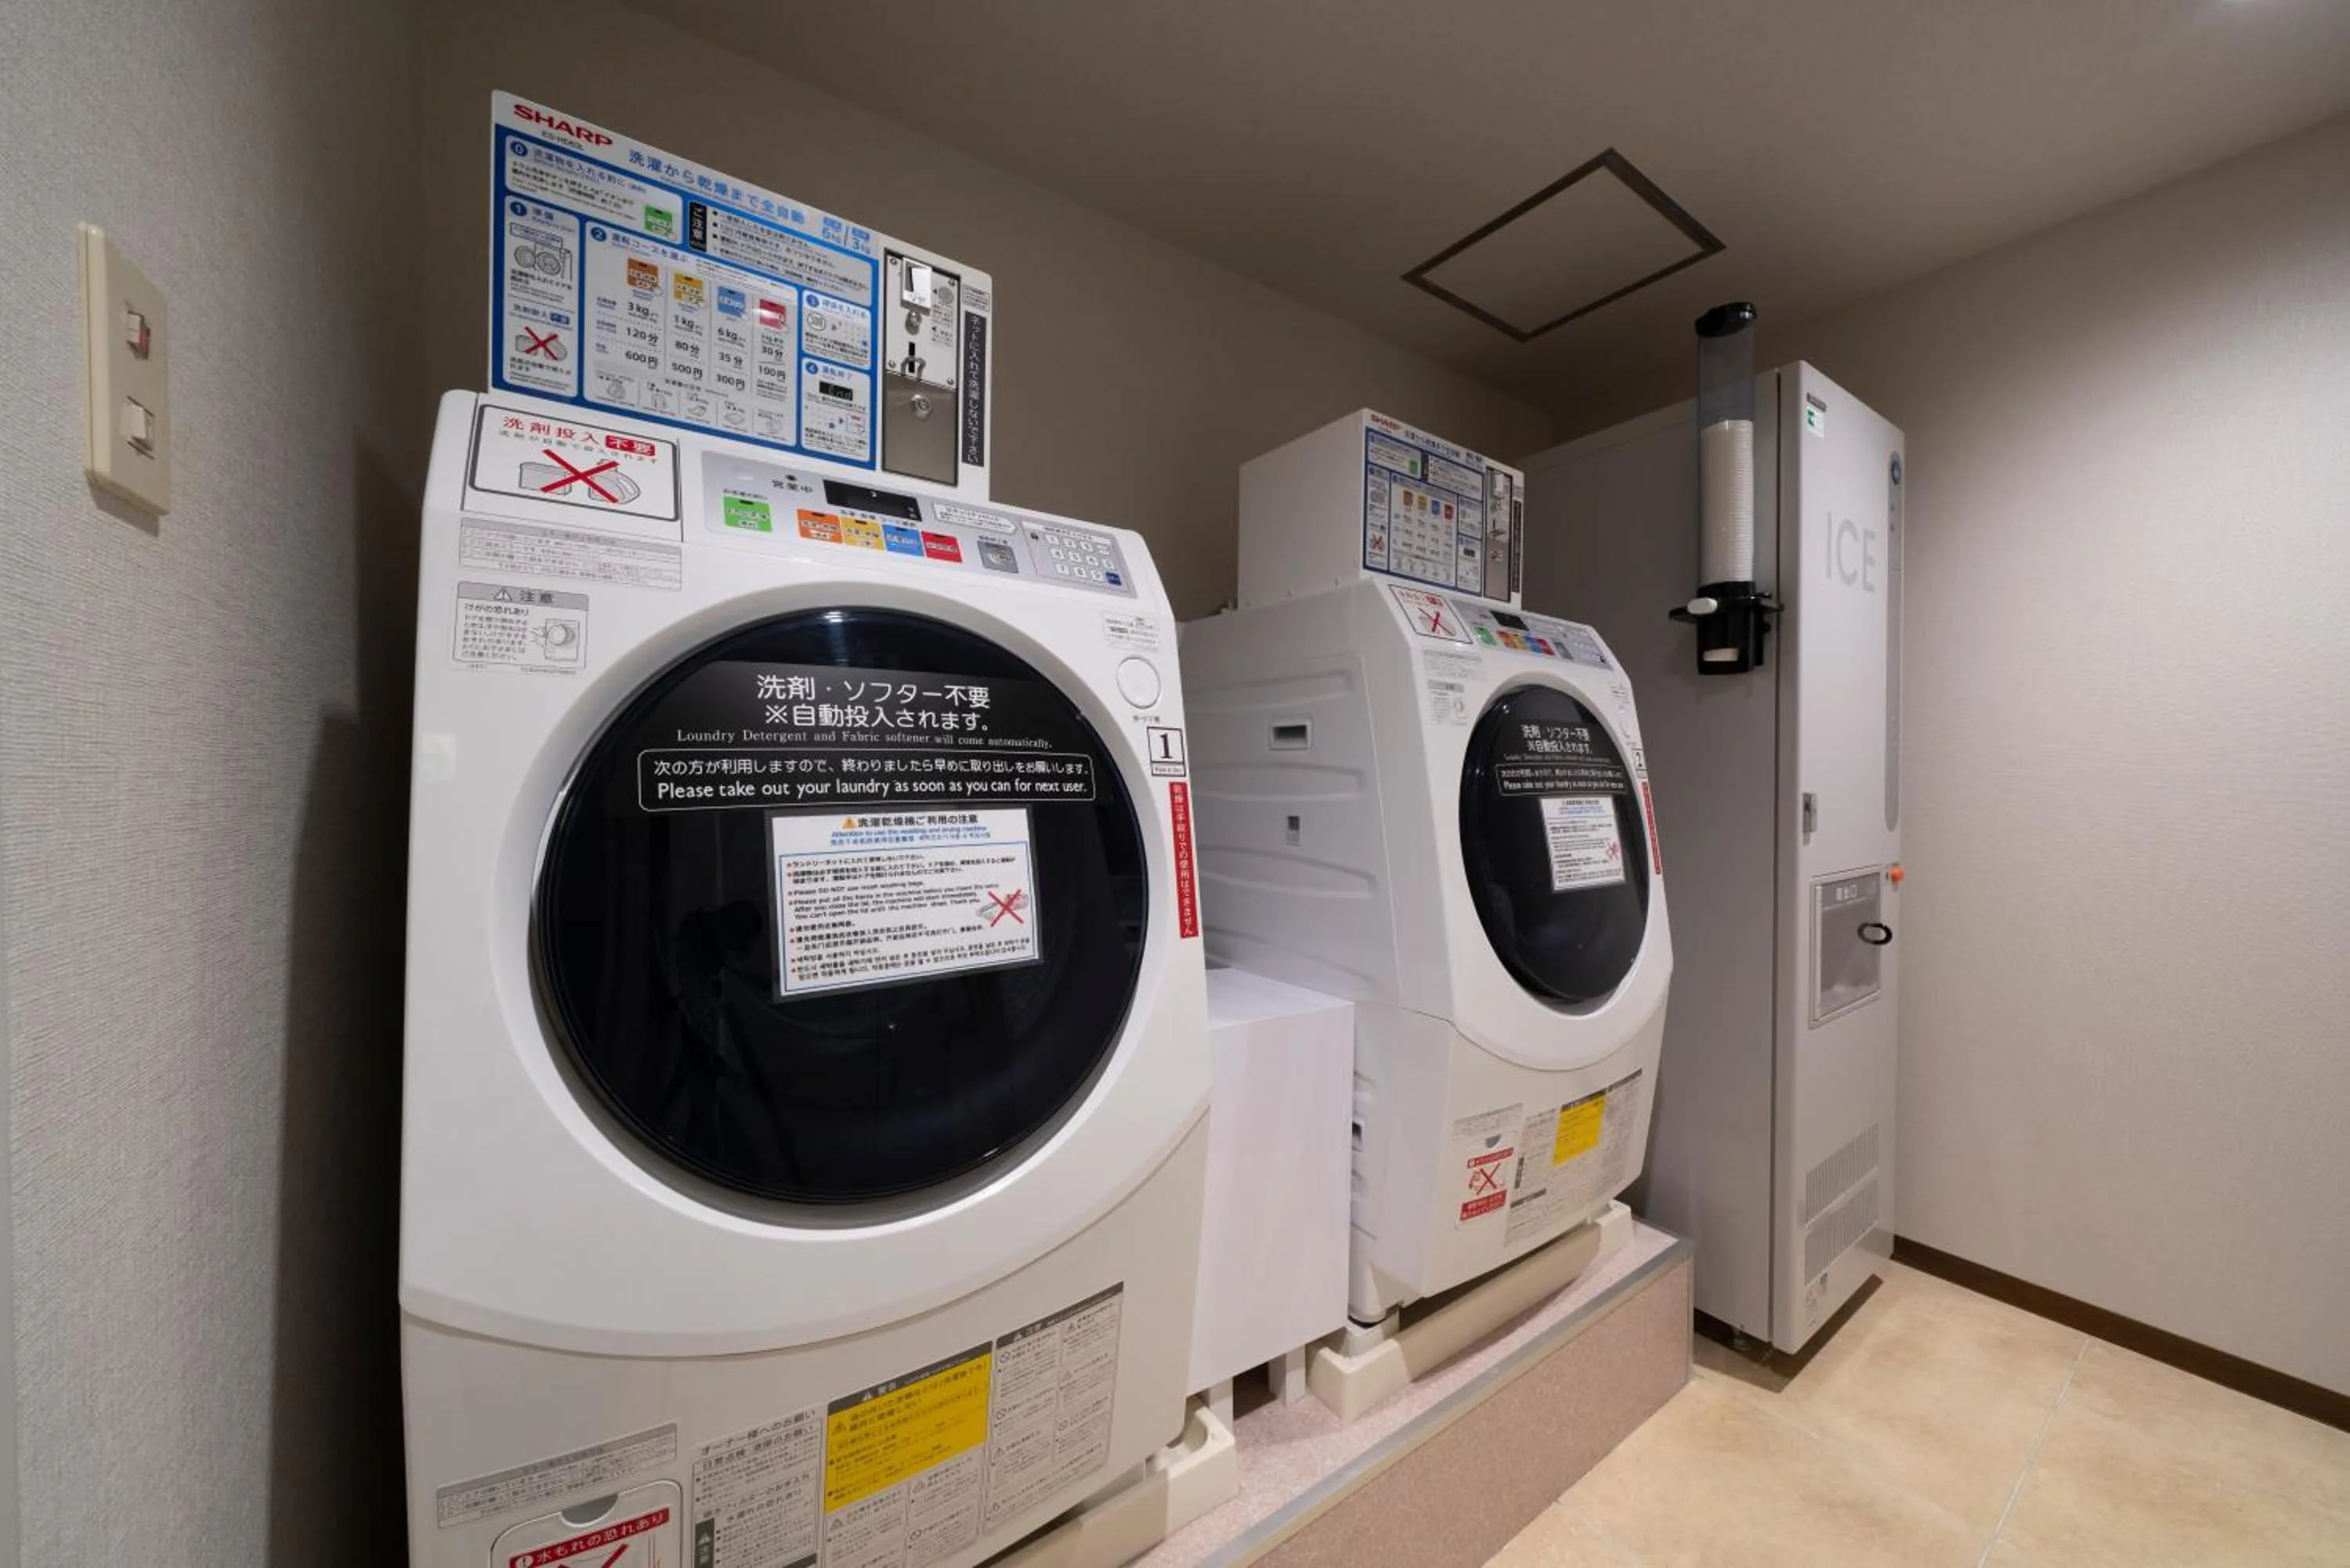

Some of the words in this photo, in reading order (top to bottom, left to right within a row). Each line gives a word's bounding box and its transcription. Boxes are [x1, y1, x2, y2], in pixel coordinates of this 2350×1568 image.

[513, 103, 613, 146] SHARP
[502, 415, 600, 446] 洗剤投入
[1825, 511, 1877, 594] ICE
[757, 674, 990, 709] 洗剤・ソフター不要
[765, 704, 989, 732] ※自動投入されます。
[677, 729, 736, 743] Loundry
[743, 729, 807, 742] Detergent
[814, 731, 836, 742] and
[841, 731, 880, 742] Fabric
[885, 733, 930, 743] softener
[1160, 733, 1173, 759] 1
[657, 782, 714, 800] Please
[719, 782, 755, 797] take
[761, 783, 790, 795] out
[797, 783, 830, 799] your
[836, 779, 889, 797] laundry
[895, 783, 909, 793] as
[913, 783, 944, 793] soon
[949, 783, 963, 793] as
[967, 782, 988, 796] you
[992, 782, 1012, 792] can
[1014, 779, 1031, 792] for
[1035, 782, 1059, 792] next
[1063, 782, 1086, 792] user.
[537, 1513, 663, 1563] 水もれの恐れあり
